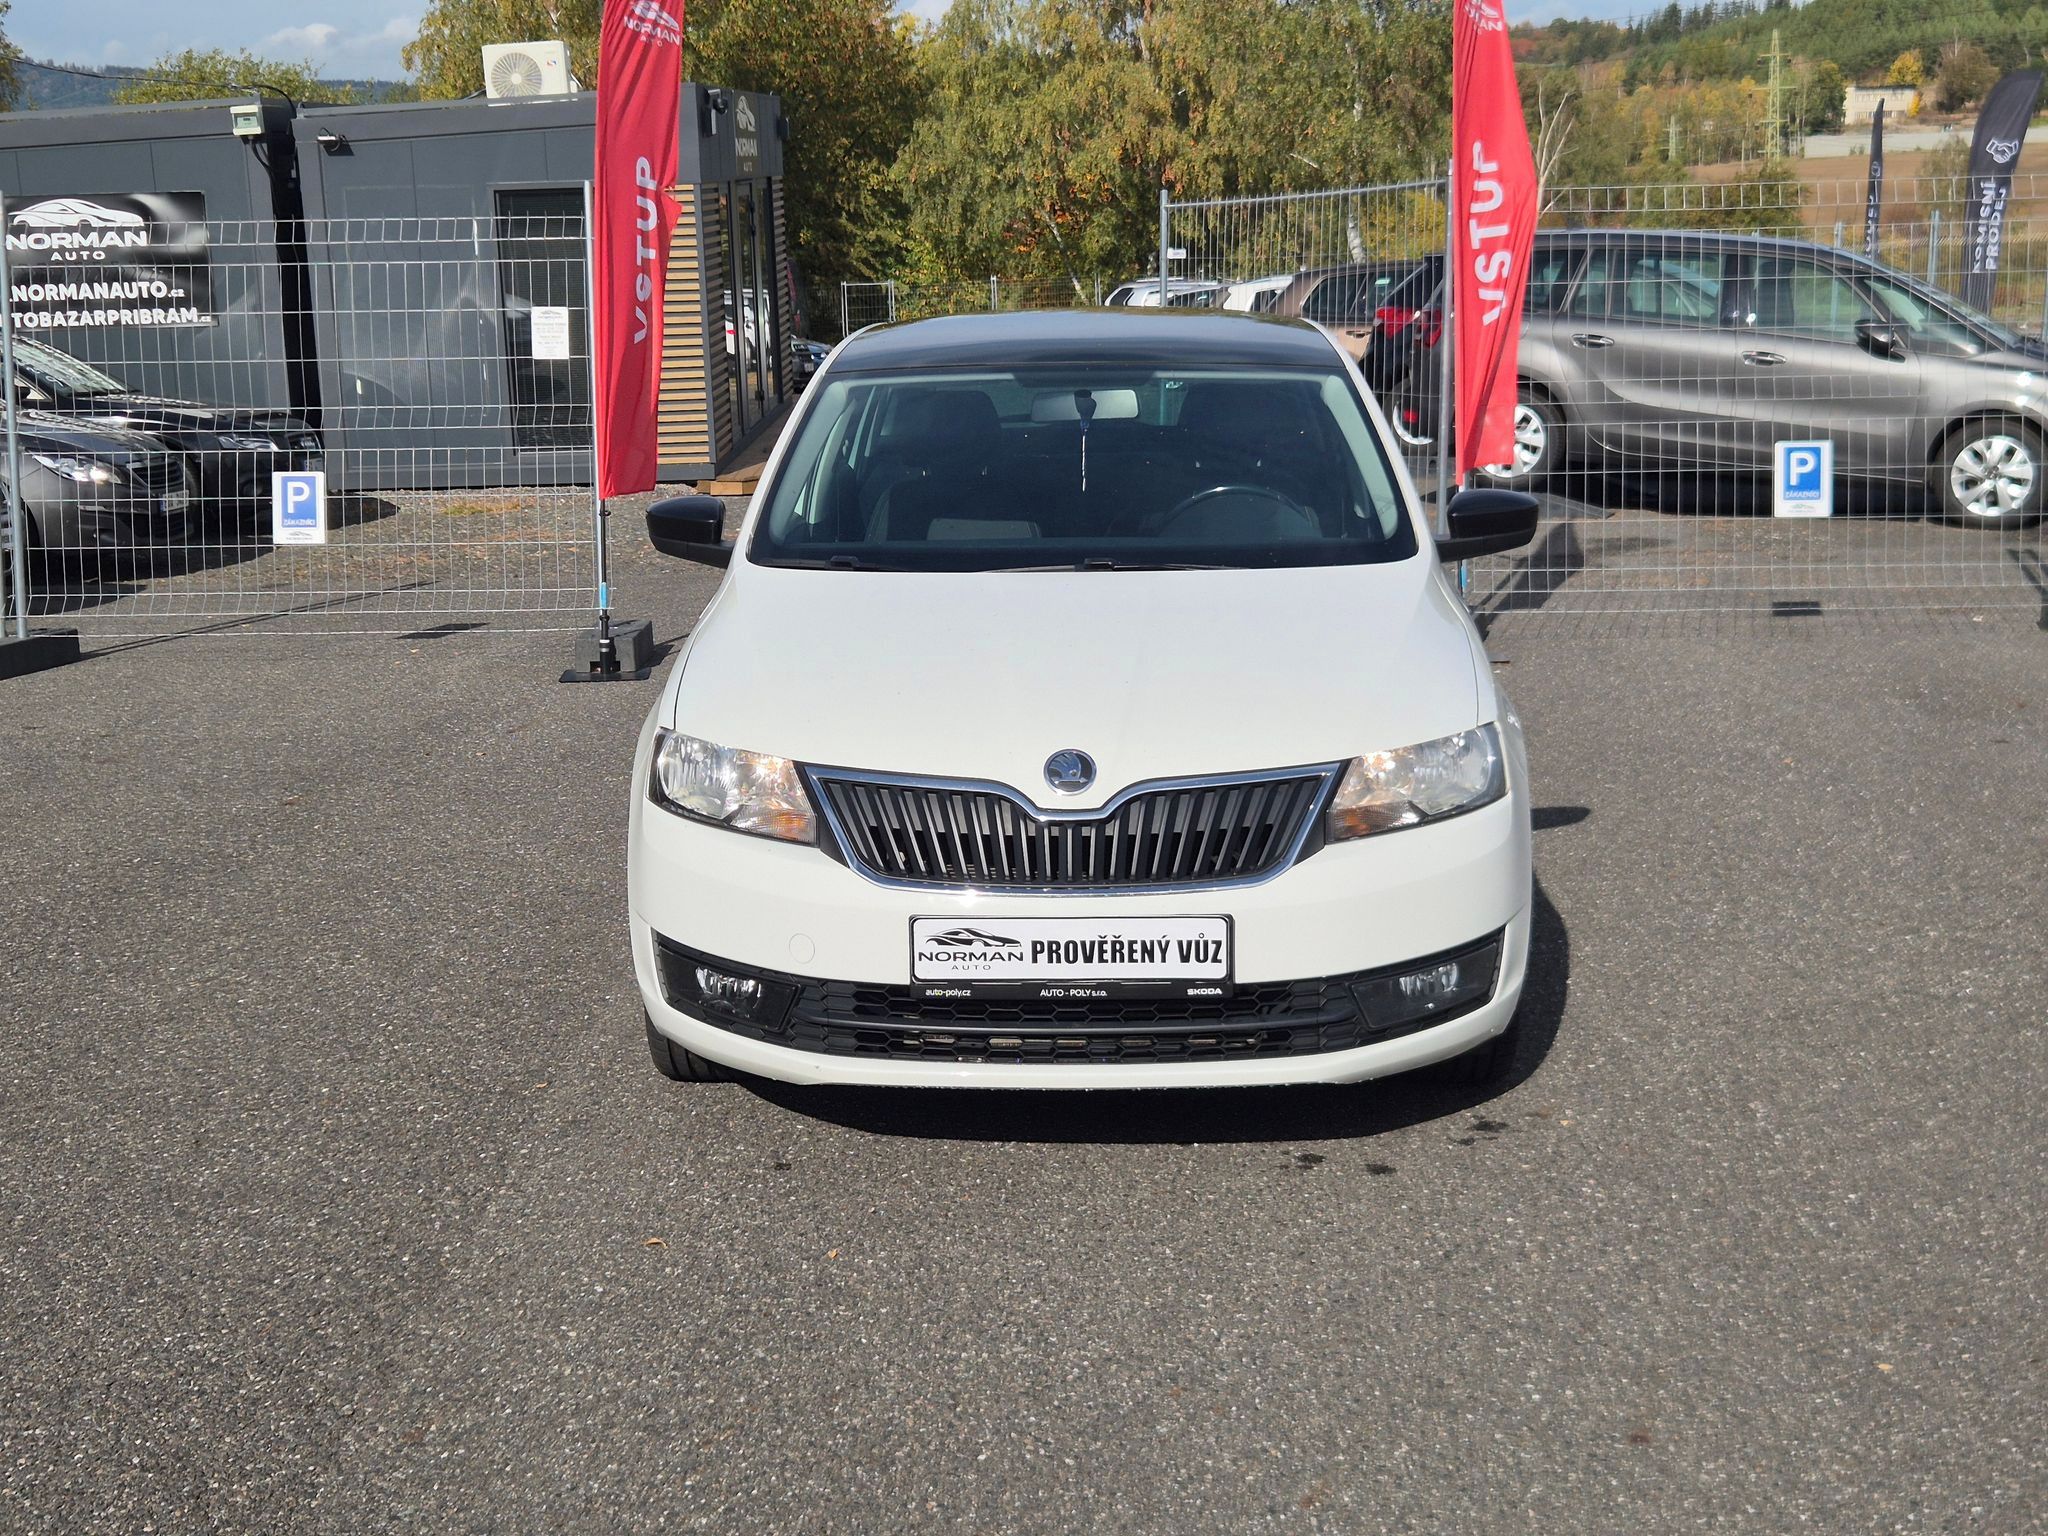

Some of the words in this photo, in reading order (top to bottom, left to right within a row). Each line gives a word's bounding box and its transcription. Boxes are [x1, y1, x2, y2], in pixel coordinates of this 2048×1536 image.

[624, 15, 680, 46] NORMAN
[640, 35, 663, 47] AO
[1985, 188, 2007, 270] PRODEJ
[5, 231, 148, 251] NORMAN
[633, 156, 658, 345] VSTUP
[51, 251, 106, 261] AUTO
[11, 307, 212, 328] TOBAZARPRIBRAM.cz
[1789, 452, 1815, 486] P
[287, 481, 310, 514] P
[918, 952, 1024, 962] NORMAN
[1031, 935, 1171, 964] PROVĚŘENÝ
[1177, 932, 1223, 964] VŮZ
[925, 988, 971, 998] auto-poly.cz
[1039, 989, 1064, 997] AUTO
[1069, 989, 1092, 997] POLY
